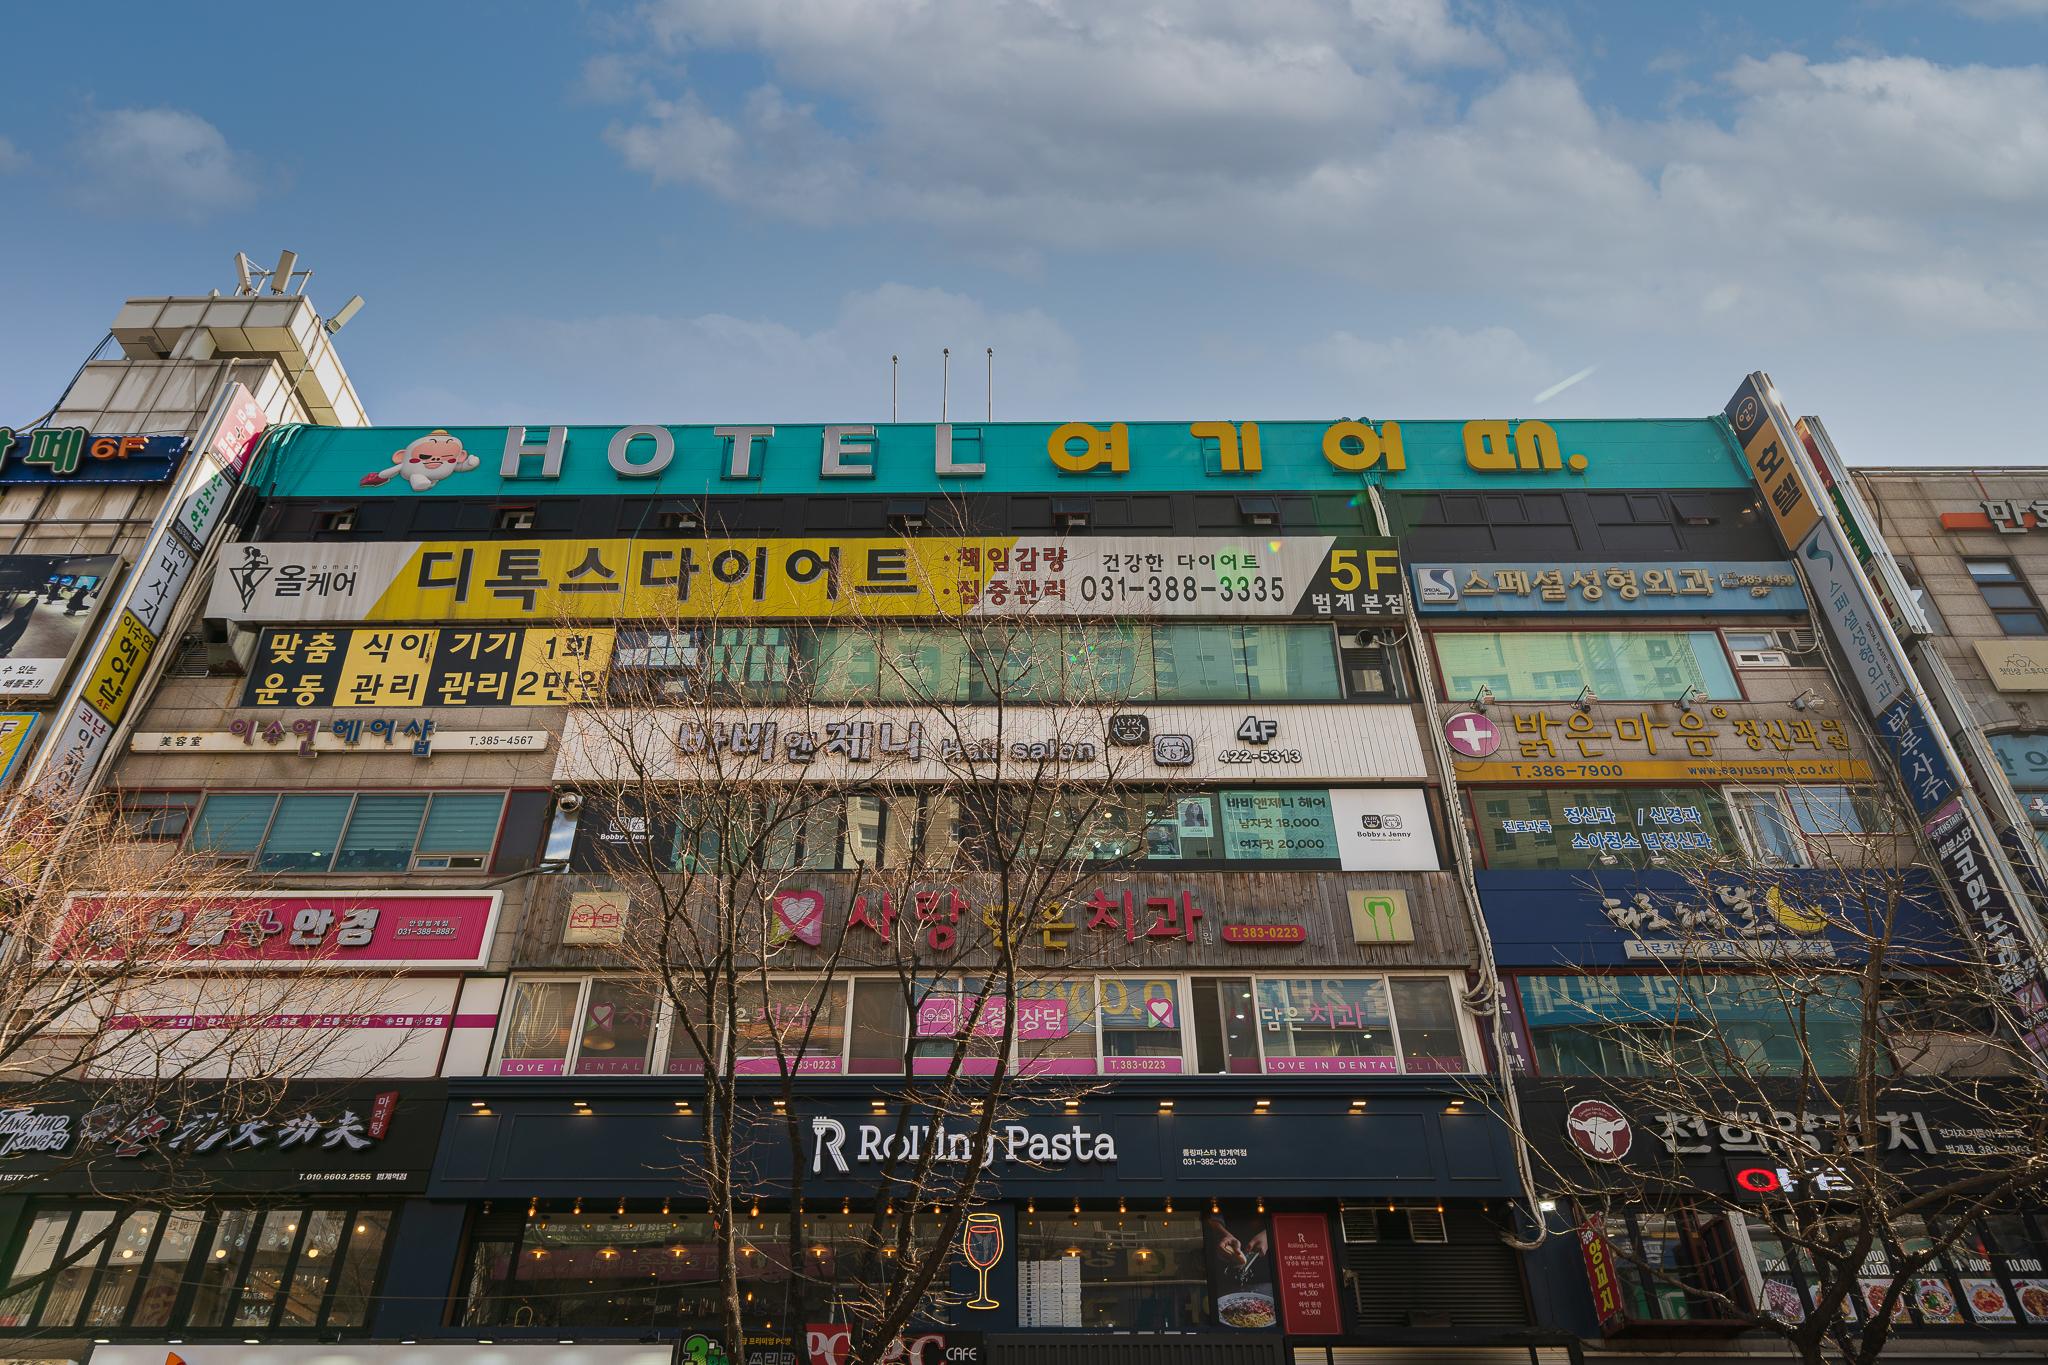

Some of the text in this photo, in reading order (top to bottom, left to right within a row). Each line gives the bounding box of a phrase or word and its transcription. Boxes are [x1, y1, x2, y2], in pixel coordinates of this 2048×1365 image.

[91, 436, 147, 459] 6F
[501, 426, 987, 477] HOTEL
[1756, 441, 1803, 517] 호텔
[166, 535, 190, 567] 타이
[957, 547, 1067, 572] 책임감량
[1103, 554, 1261, 574] 건강한 다이어트
[1330, 549, 1399, 592] 5F
[138, 556, 178, 628] 마사지
[275, 565, 356, 598] 올케어
[416, 547, 920, 612] 디톡스다이어트
[1081, 576, 1284, 602] 031-388-3335
[1462, 568, 1716, 602] 스페셜성형외과
[1750, 586, 1772, 598] 5F
[957, 580, 1066, 605] 집중관리
[1312, 592, 1404, 615] 범계 본점
[123, 615, 155, 653] 이수연
[449, 631, 516, 660] 기기
[1829, 579, 1892, 704] 스페셜성형외과
[270, 633, 336, 664] 맞춤
[363, 633, 429, 662] 식이
[545, 636, 594, 661] 1회
[16, 665, 38, 675] 있는
[98, 636, 140, 705] 헤어샵
[255, 673, 325, 706] 운동
[350, 673, 420, 704] 관리
[438, 671, 508, 704] 관리
[517, 671, 602, 702] 2만원
[95, 697, 110, 712] 4F
[79, 708, 106, 738] 코난
[1236, 716, 1278, 745] 4F
[1514, 709, 1721, 758] 밝은마음
[1733, 719, 1822, 751] 정신과
[159, 736, 203, 748] 美容室
[228, 718, 438, 758] 이수연 헤어샵
[468, 735, 534, 746] T.385-4567
[1010, 739, 1096, 764] salon
[1217, 748, 1302, 764] 422-5313
[1511, 763, 1834, 778] T.386-7900 www.sayusayme.co.kr
[1298, 796, 1326, 809] 헤어
[1563, 806, 1616, 824] 정신과
[1650, 806, 1702, 824] 신경과
[1239, 818, 1320, 830] 남자컷 18,000
[1502, 819, 1552, 833] 진료과목
[1239, 839, 1325, 851] 여자컷 20,000
[289, 907, 382, 946] 안경
[849, 889, 971, 950] 사랑
[1086, 888, 1205, 944] 치과
[1230, 927, 1299, 939] T.383-0223
[424, 1017, 442, 1026] 안경
[1020, 1008, 1064, 1031] 상담
[1261, 1002, 1367, 1031] 담은 치과
[506, 1063, 546, 1073] LOVE
[1110, 1059, 1166, 1070] T.383-0223
[1268, 1061, 1306, 1070] LOVE
[1315, 1061, 1329, 1070] IN
[1339, 1060, 1397, 1070] DENTAL
[371, 1096, 391, 1136] 마라탕
[1005, 1124, 1117, 1162] Pasta
[1182, 1148, 1248, 1157] 롤링파스타 범계역점
[1182, 1158, 1237, 1166] 031-382-0520
[299, 1173, 371, 1181] T.010.6603.2555
[1588, 1238, 1615, 1313] 양꼬치
[2006, 1258, 2042, 1272] 10,000
[946, 1346, 977, 1362] CAFE
